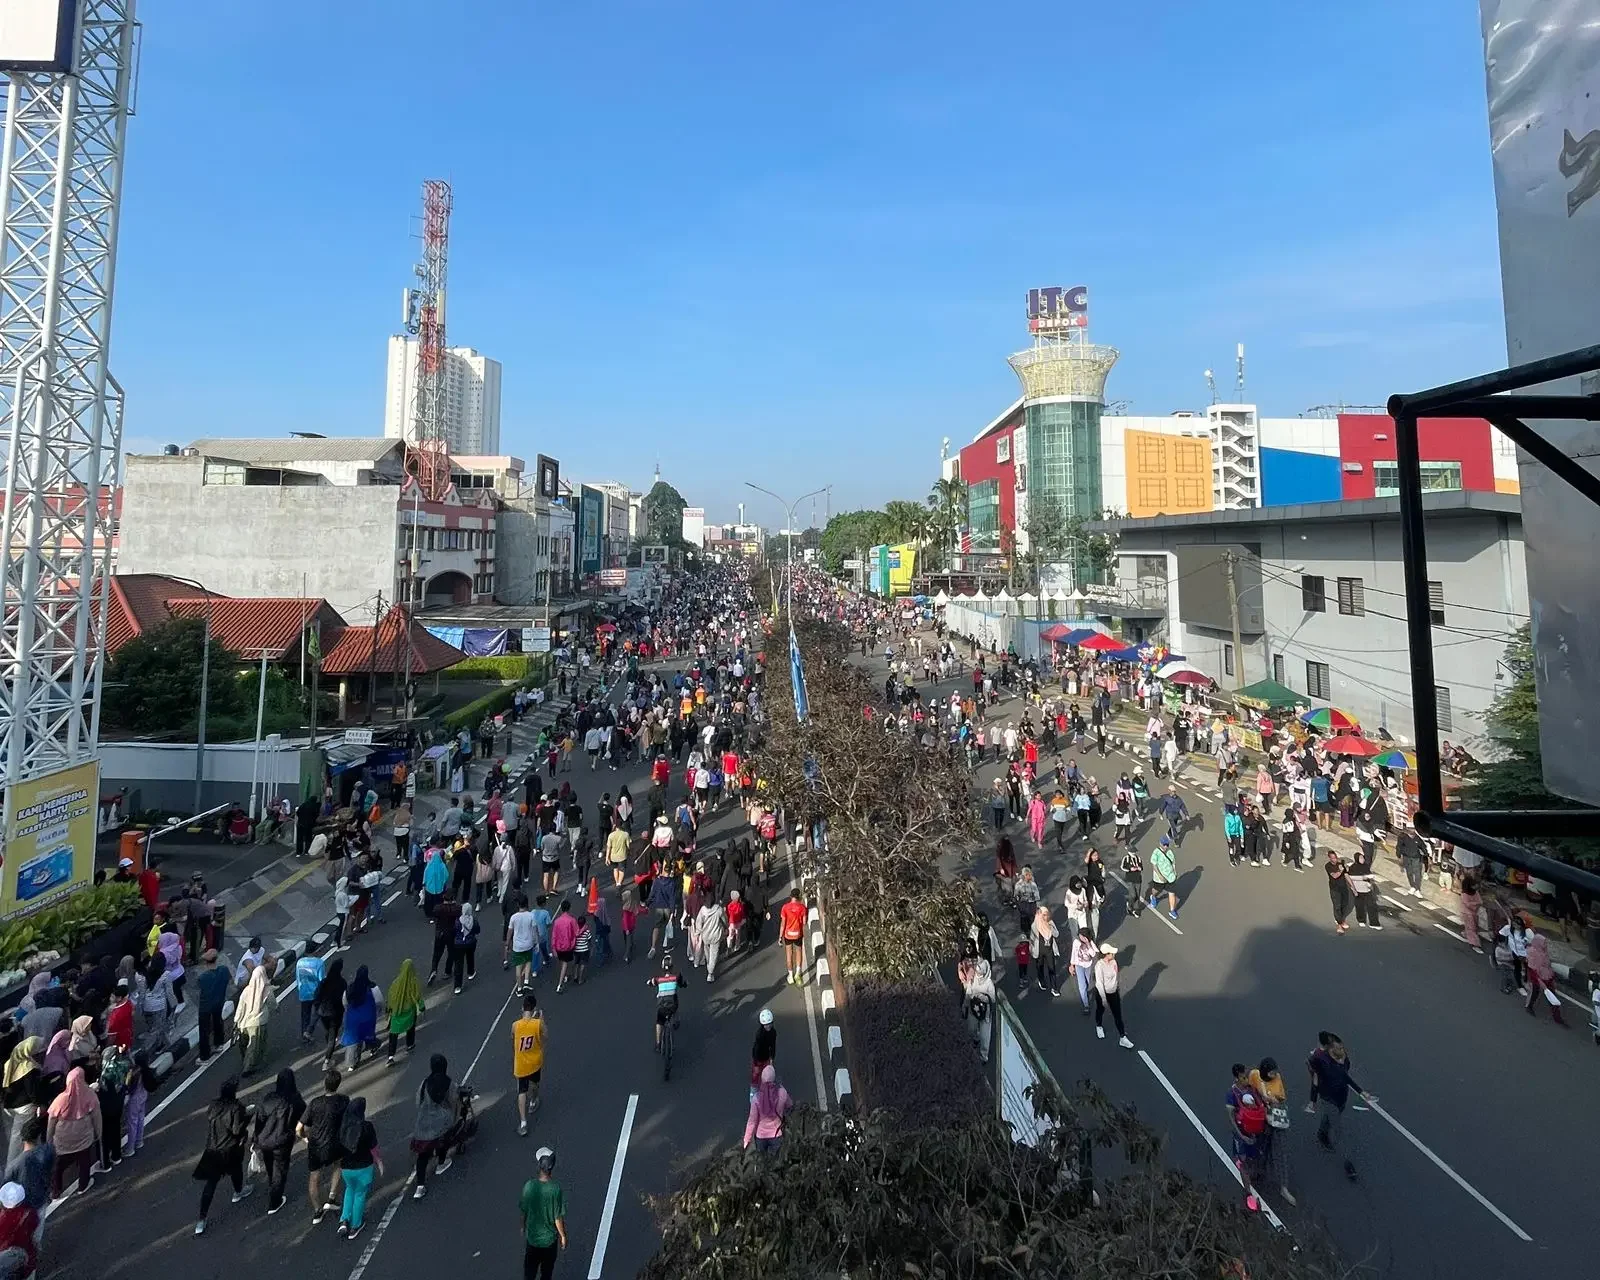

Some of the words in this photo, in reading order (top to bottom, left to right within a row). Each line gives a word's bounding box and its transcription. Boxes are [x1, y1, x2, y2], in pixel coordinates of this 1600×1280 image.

[1029, 285, 1088, 316] ITC
[1038, 317, 1078, 328] DEPOK
[17, 804, 42, 820] KAMI
[42, 790, 88, 810] MENERIMA
[38, 804, 69, 821] KARTU
[519, 1035, 535, 1052] 19
